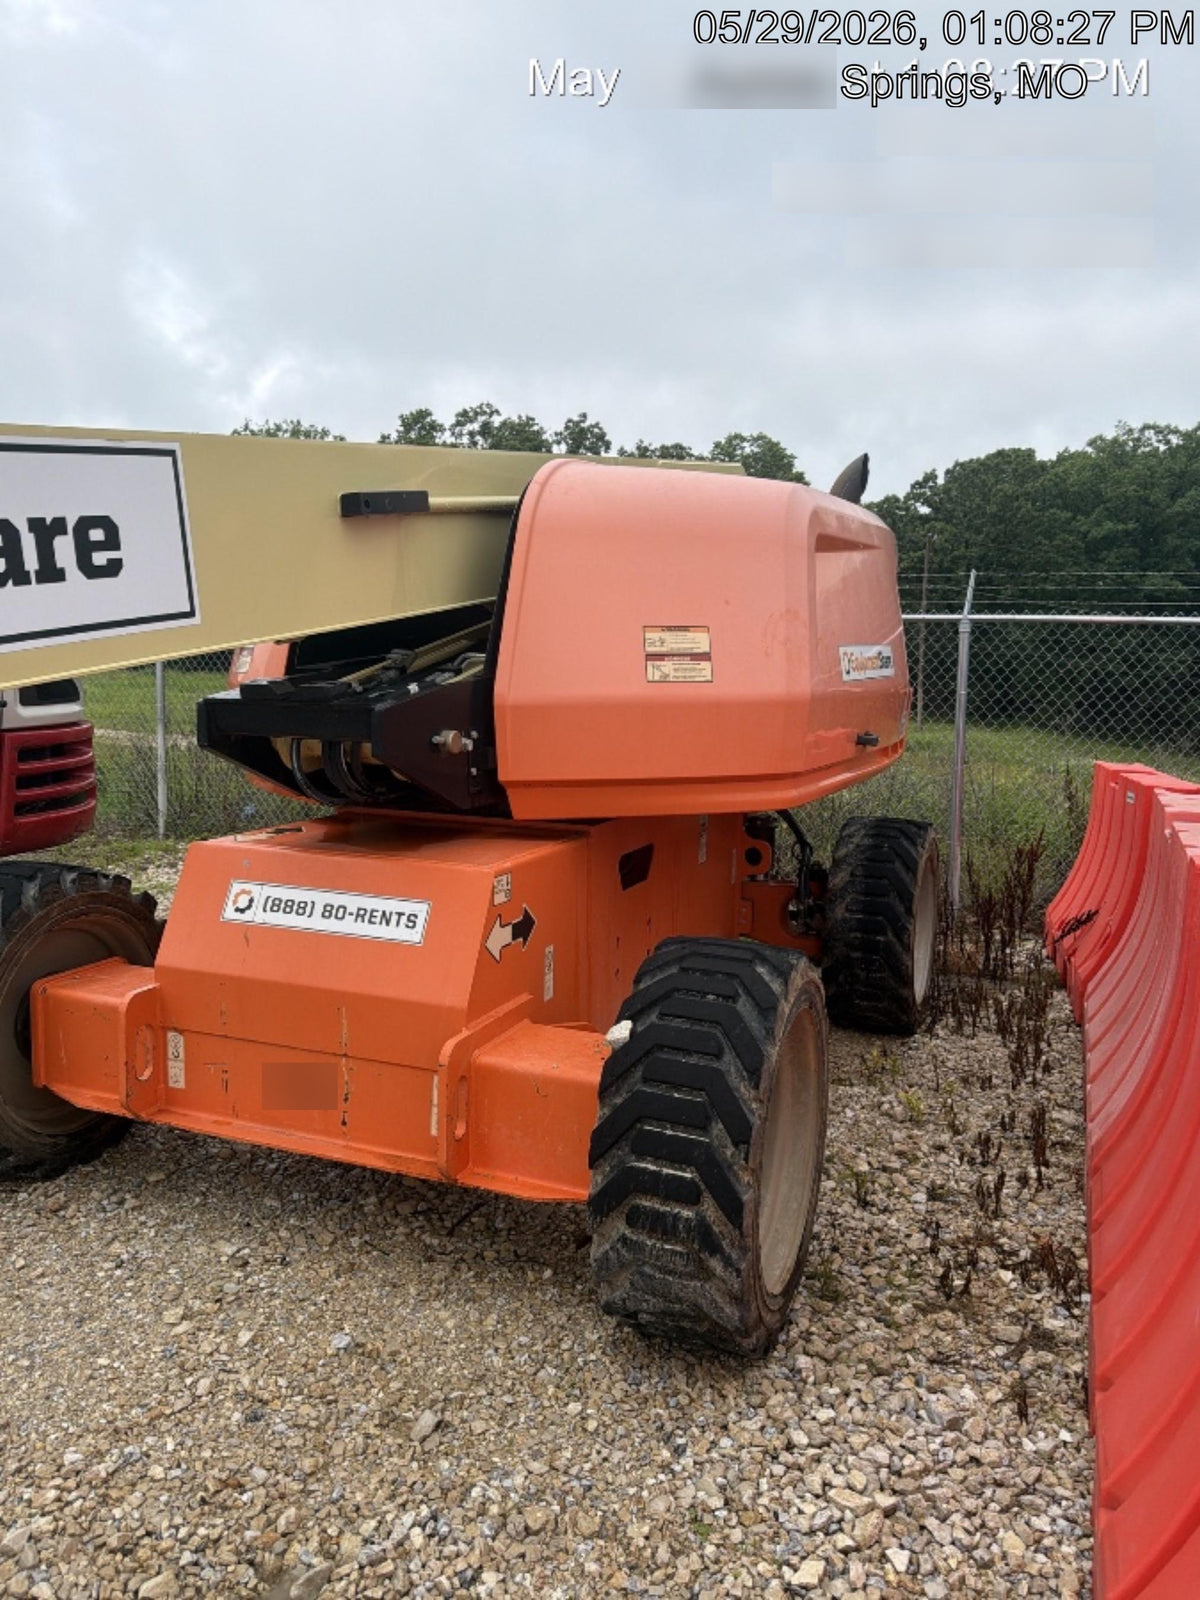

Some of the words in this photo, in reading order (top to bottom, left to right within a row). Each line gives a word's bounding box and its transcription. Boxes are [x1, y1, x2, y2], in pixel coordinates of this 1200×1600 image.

[0, 515, 123, 589] are
[262, 895, 315, 918] (888)
[321, 903, 419, 930] 80-RENTS
